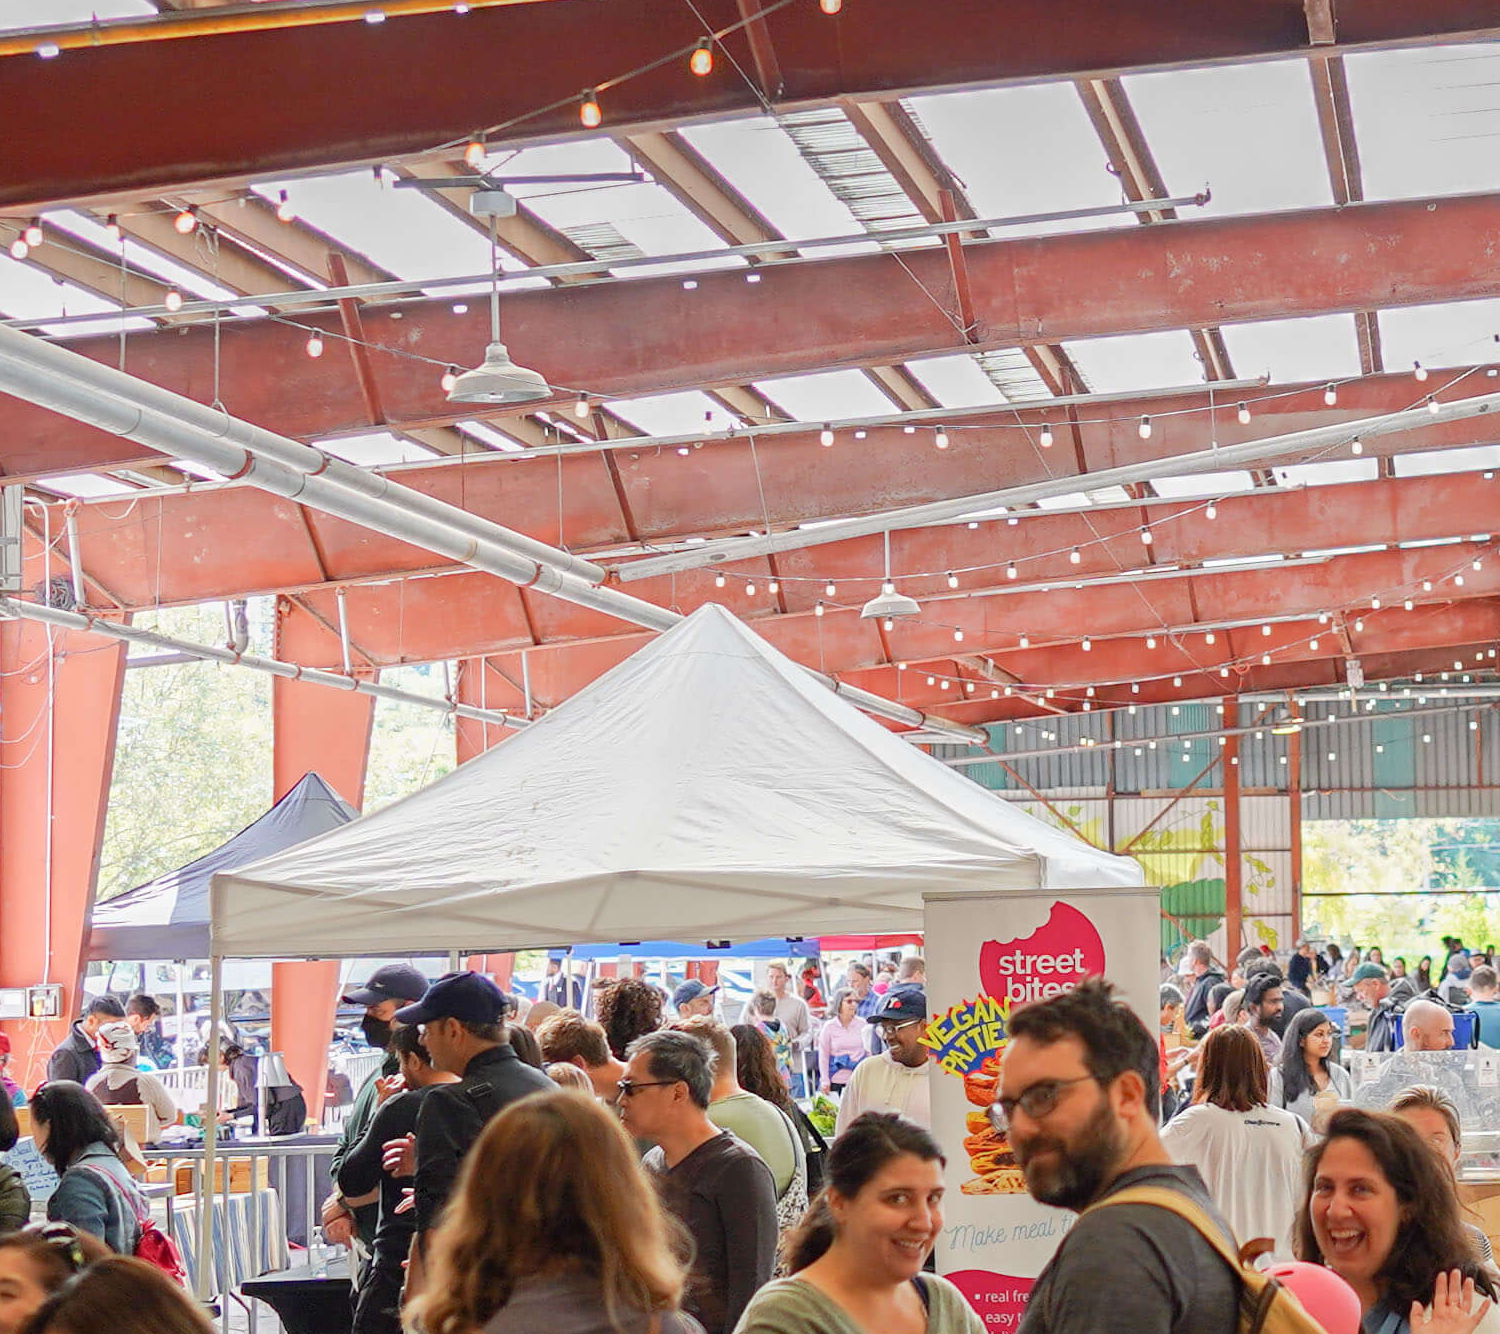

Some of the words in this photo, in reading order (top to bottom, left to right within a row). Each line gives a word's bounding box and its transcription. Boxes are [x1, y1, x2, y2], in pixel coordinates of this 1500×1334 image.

[999, 948, 1086, 975] street
[916, 996, 1011, 1051] VEGAN
[944, 1224, 1008, 1252] Make
[1012, 1216, 1056, 1241] meal
[985, 1290, 1009, 1303] real
[985, 1313, 1014, 1327] easy
